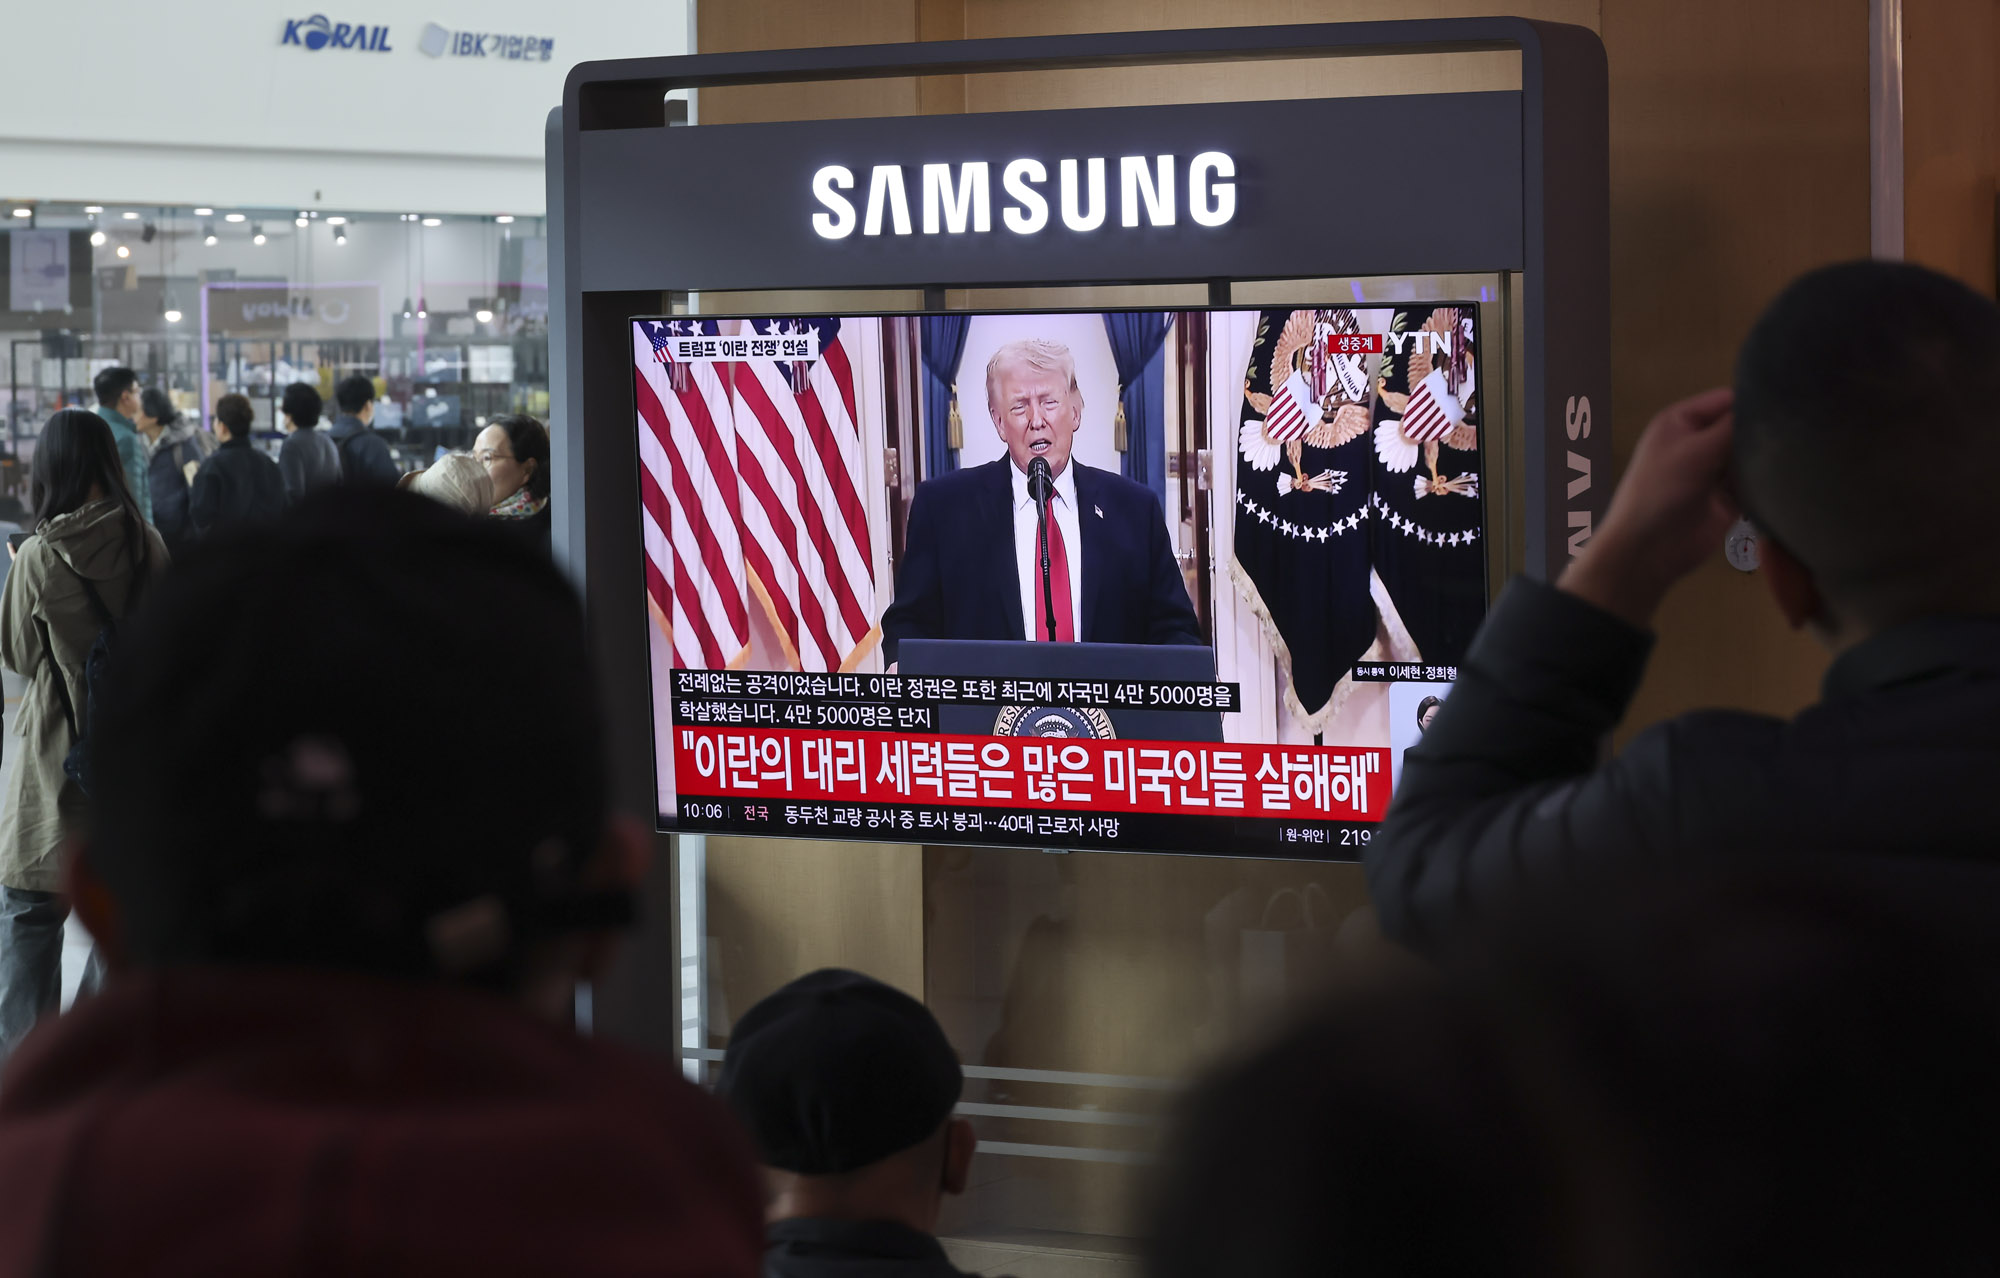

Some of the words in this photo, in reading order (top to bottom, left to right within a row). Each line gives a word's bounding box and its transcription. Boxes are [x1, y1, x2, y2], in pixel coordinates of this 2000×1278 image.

[281, 14, 392, 52] KORAIL
[811, 150, 1236, 240] SAMSUNG
[678, 341, 717, 357] 트럼프
[783, 339, 809, 356] 연설
[1338, 337, 1374, 352] 생중계
[1387, 331, 1452, 356] YTN
[678, 673, 742, 694] 전례없는
[745, 674, 865, 697] 공격이었습니다.
[869, 677, 902, 698] 이란
[907, 678, 958, 700] 정권은
[962, 679, 996, 701] 또한
[1001, 680, 1052, 702] 최근에
[1057, 681, 1109, 703] 자국민
[1114, 683, 1143, 704] 4만
[1149, 685, 1232, 708] 5000명을
[680, 701, 780, 723] 학살했습니다.
[784, 704, 811, 724] 4만
[817, 706, 893, 727] 5000명은
[898, 707, 931, 728] 단지
[682, 730, 793, 792] "이란의
[801, 738, 867, 794] 대리
[875, 739, 1015, 799] 세력들은
[1022, 745, 1094, 803] 많은
[1103, 747, 1247, 809] 미국인들
[1254, 751, 1380, 814] 살해해"
[683, 803, 723, 819] 10:06
[743, 805, 769, 822] 전국
[784, 805, 829, 827] 동두천
[832, 807, 862, 828] 교량
[865, 809, 897, 829] 공사
[900, 810, 914, 829] 중
[918, 811, 949, 831] 토사
[1036, 815, 1084, 836] 근로자
[1087, 817, 1120, 838] 사망
